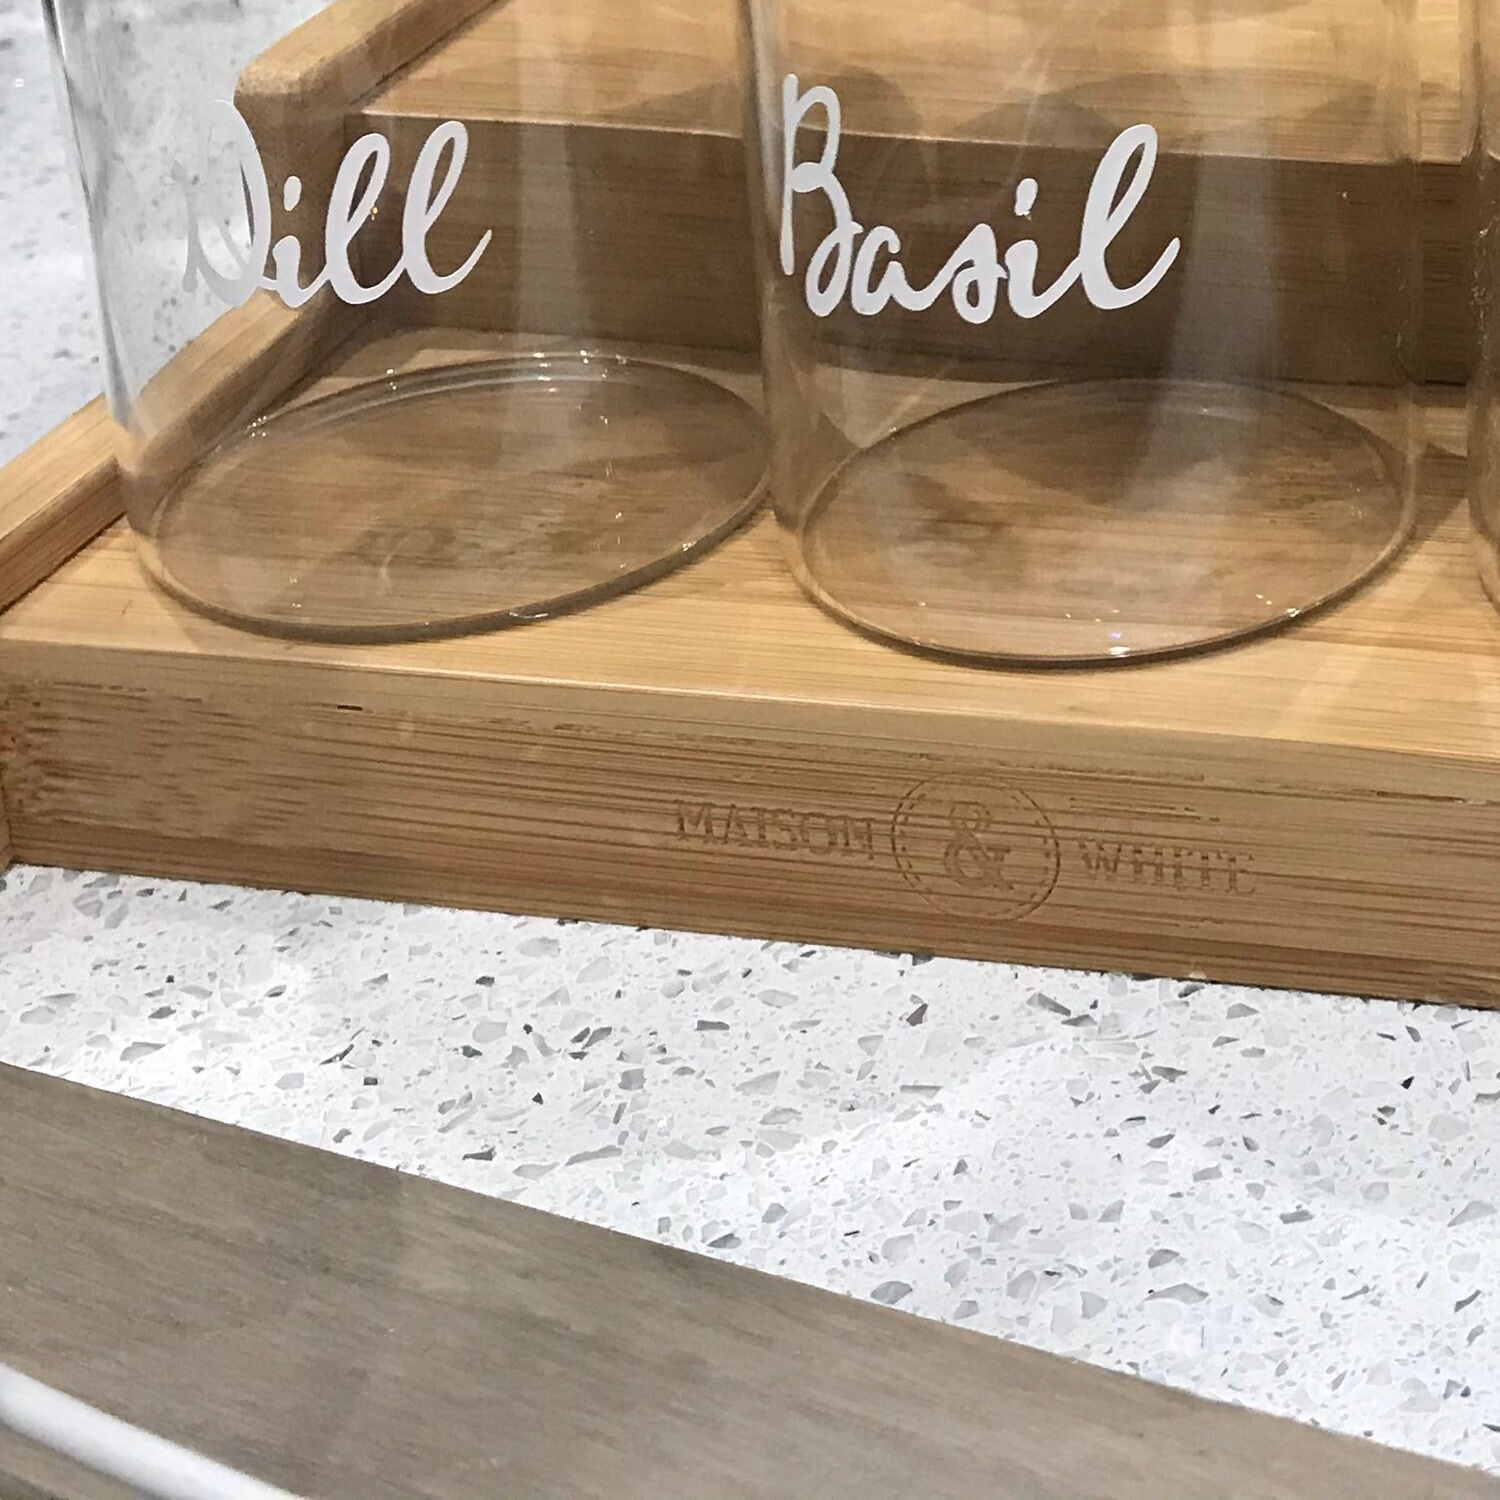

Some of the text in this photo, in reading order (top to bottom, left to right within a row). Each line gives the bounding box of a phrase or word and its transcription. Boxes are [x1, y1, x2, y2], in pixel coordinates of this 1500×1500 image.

[170, 99, 494, 308] Dill
[780, 73, 1182, 325] Basil
[674, 798, 1257, 895] MAISON & WHITE
